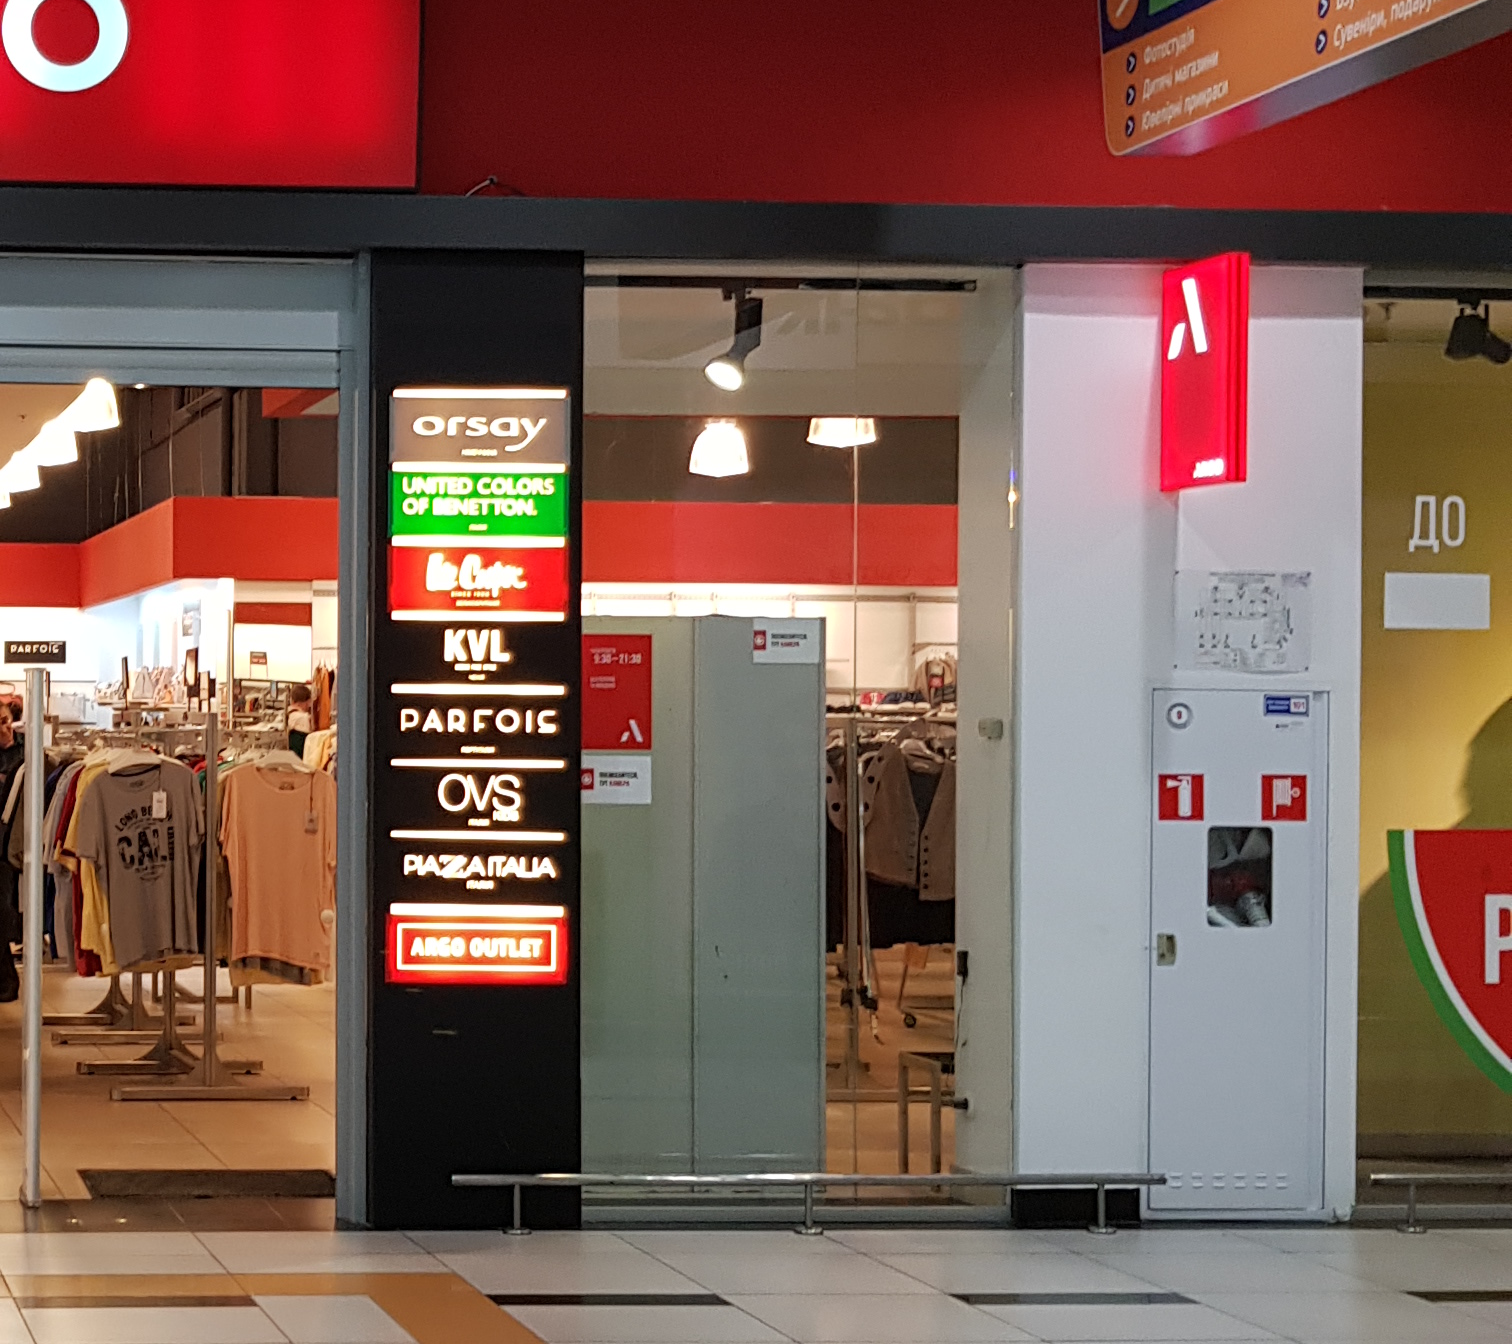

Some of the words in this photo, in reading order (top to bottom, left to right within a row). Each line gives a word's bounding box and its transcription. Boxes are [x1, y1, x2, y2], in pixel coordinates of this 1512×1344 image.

[413, 415, 547, 452] orsay
[402, 476, 473, 495] UNITED
[477, 477, 555, 496] COLORS
[402, 497, 429, 515] OF
[1409, 496, 1466, 553] ДО
[444, 629, 511, 662] KVL
[400, 709, 557, 733] PARFOIS
[438, 773, 521, 811] OVS
[410, 937, 465, 957] ARGO
[469, 937, 543, 958] OUTLET
